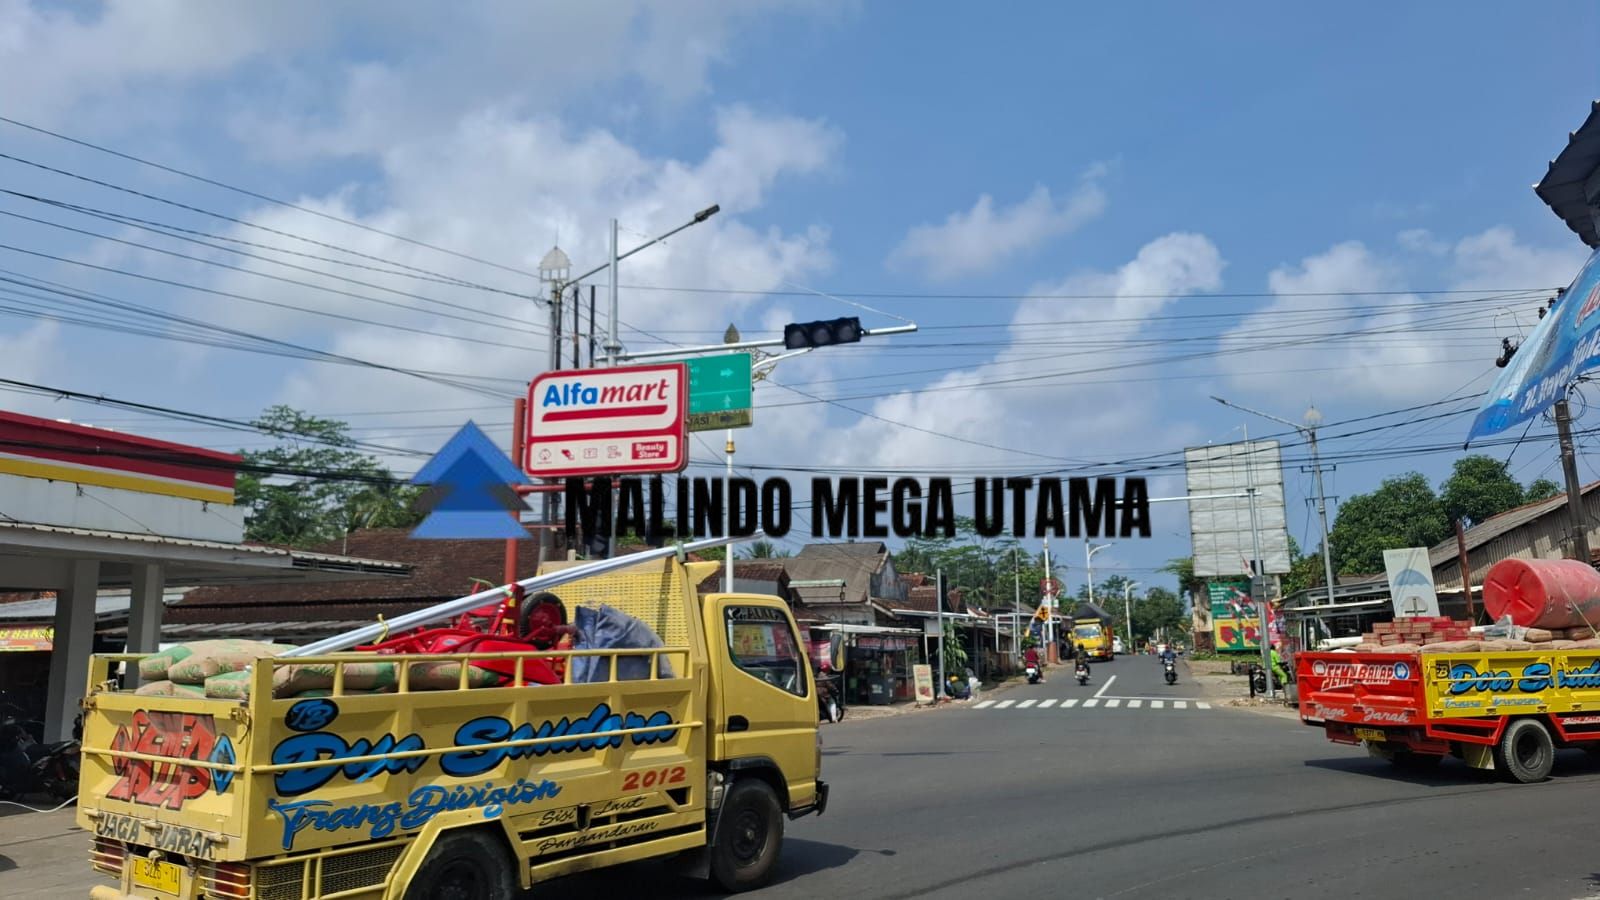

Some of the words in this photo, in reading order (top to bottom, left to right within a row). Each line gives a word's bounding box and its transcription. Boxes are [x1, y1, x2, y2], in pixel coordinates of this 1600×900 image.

[542, 379, 669, 408] Alfamart
[636, 443, 665, 452] Beauty
[638, 451, 660, 459] Store
[272, 731, 430, 797] Dua
[439, 702, 680, 778] Saudara
[622, 766, 687, 791] 2012
[268, 798, 402, 850] Trans
[401, 777, 562, 830] Division
[594, 796, 647, 816] Laut
[96, 811, 141, 842] JAGA
[536, 821, 660, 855] Pangandaran
